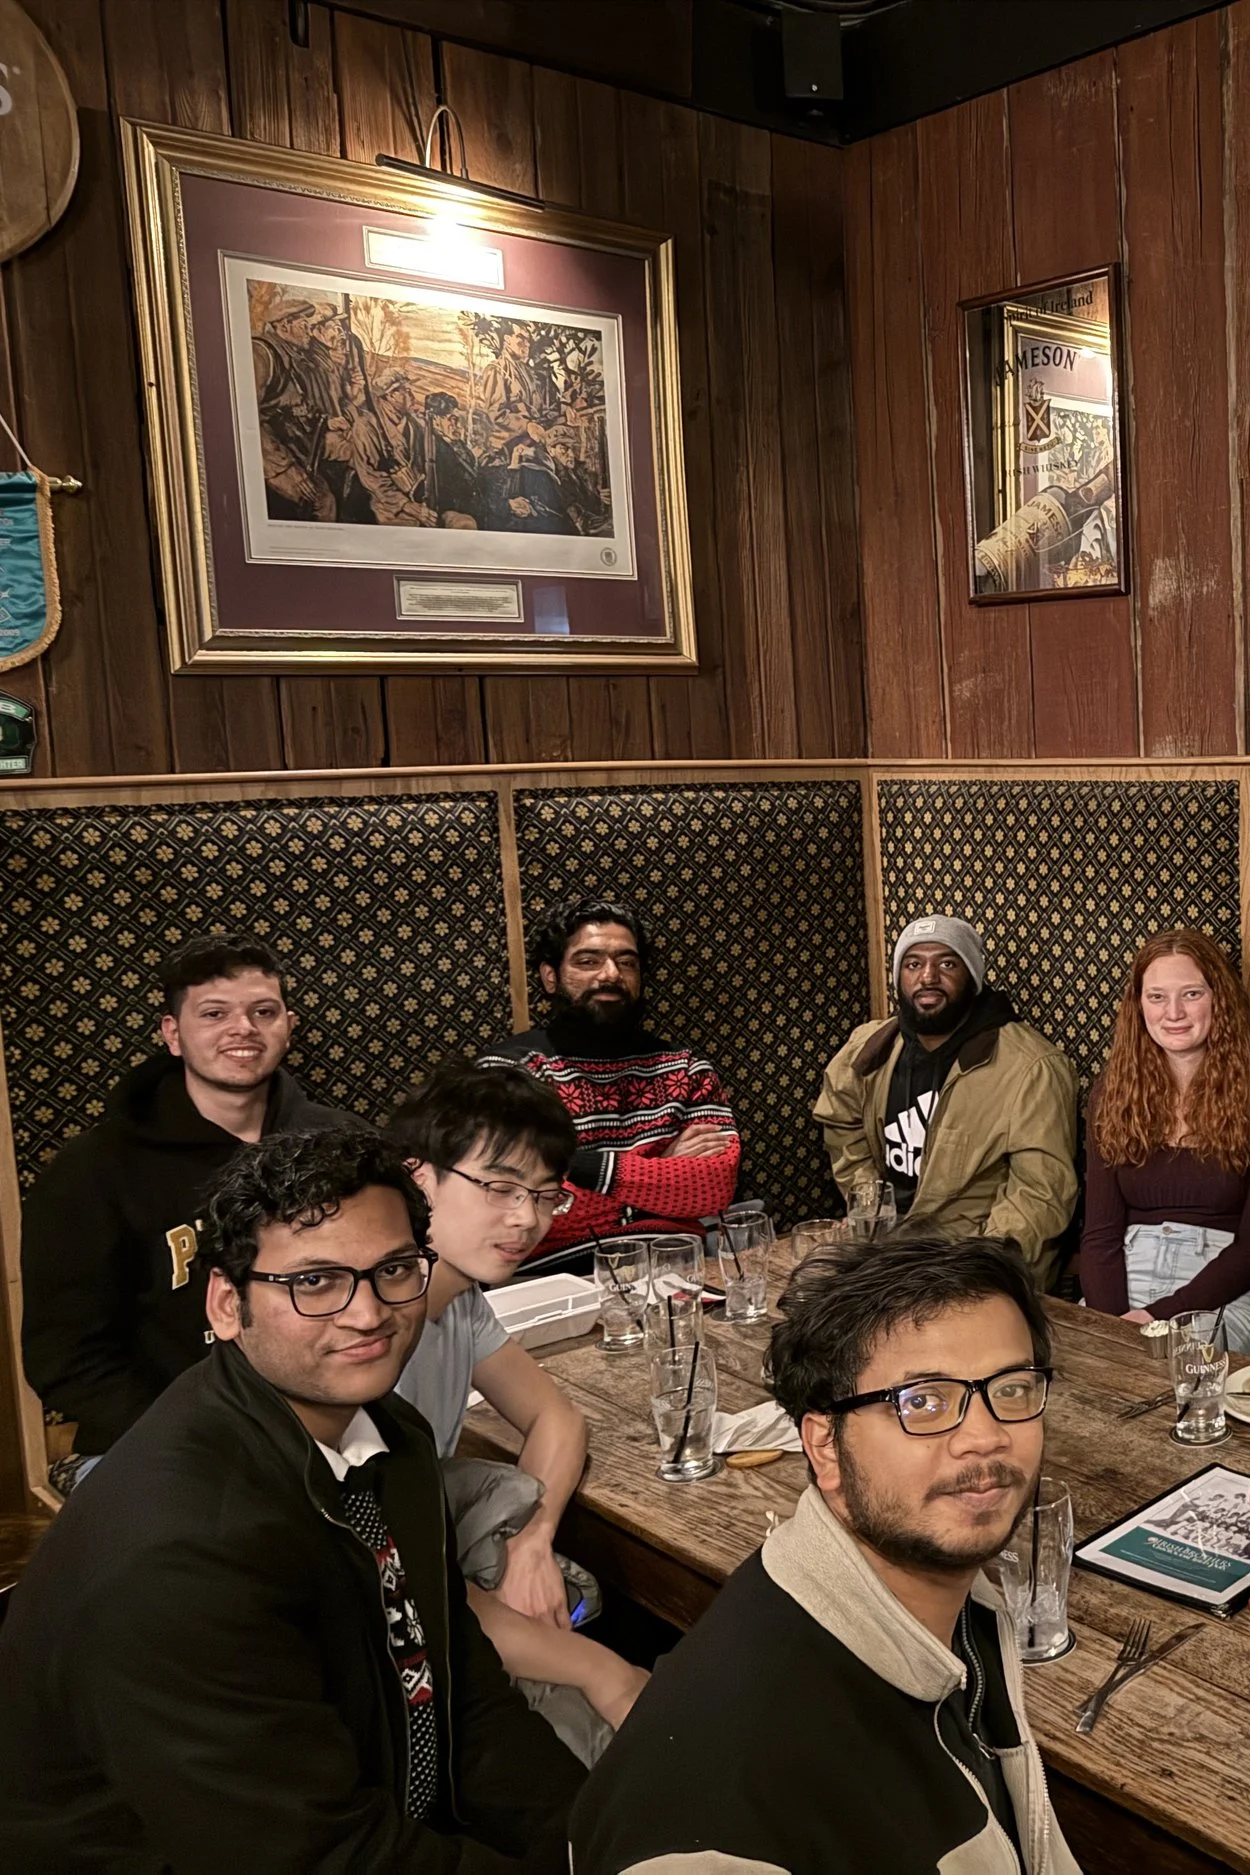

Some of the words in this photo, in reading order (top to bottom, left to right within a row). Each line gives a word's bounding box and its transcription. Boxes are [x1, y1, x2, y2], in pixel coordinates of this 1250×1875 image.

[1052, 290, 1093, 313] Ireland
[995, 345, 1077, 387] JAMESON
[1004, 465, 1031, 478] RISH
[1032, 459, 1078, 475] WHISKEY
[1185, 1360, 1226, 1375] GUINNESS
